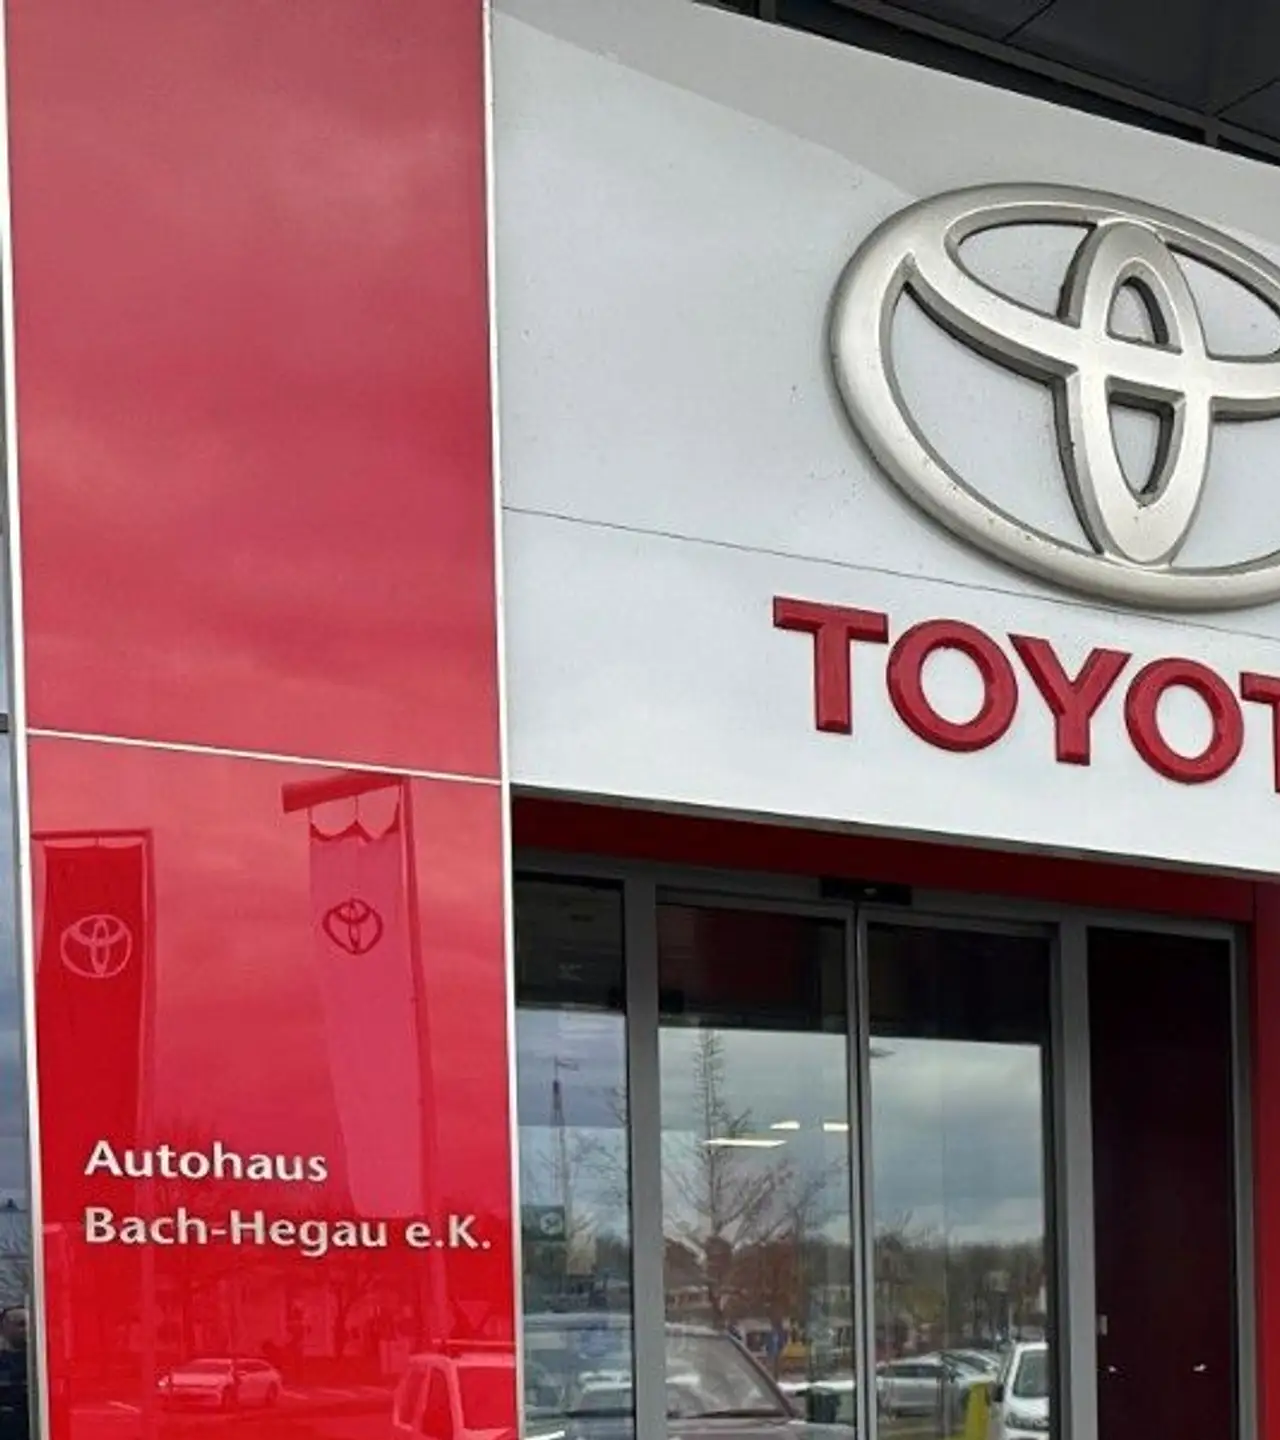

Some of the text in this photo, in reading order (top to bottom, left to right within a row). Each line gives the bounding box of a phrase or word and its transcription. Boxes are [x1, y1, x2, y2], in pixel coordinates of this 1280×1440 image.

[84, 1139, 328, 1182] Autohaus
[84, 1206, 492, 1257] Bach-Hegau e.K.
